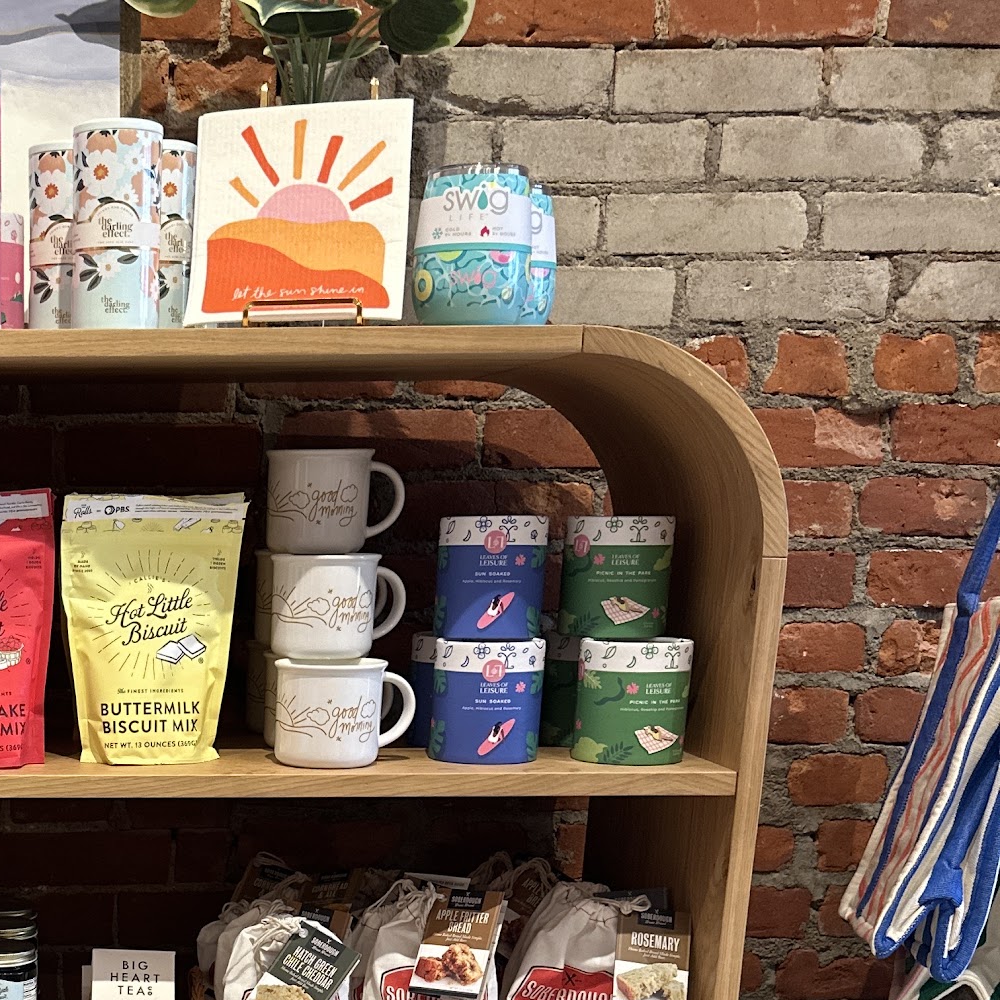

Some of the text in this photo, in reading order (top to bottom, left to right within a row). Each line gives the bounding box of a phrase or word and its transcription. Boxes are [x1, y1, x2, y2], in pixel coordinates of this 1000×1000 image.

[443, 184, 508, 215] swig
[98, 216, 113, 225] the
[101, 222, 133, 232] darling
[232, 285, 366, 301] let the sun shine in
[308, 479, 342, 522] good
[319, 504, 357, 527] morning
[105, 588, 193, 628] Hot Little
[122, 618, 187, 646] Biscuit
[100, 701, 200, 716] BUTTERMILK
[102, 718, 198, 734] BISCUIT MIX
[144, 740, 176, 748] OUNCES
[436, 910, 490, 924] APPLE FRITTER
[447, 922, 472, 934] BREAD
[631, 931, 681, 952] ROSEMARY
[122, 960, 148, 970] BIG
[292, 945, 338, 978] HATCH GREEN
[110, 972, 160, 983] HEART
[282, 954, 304, 973] CHILE
[301, 963, 334, 990] CHEDDAR
